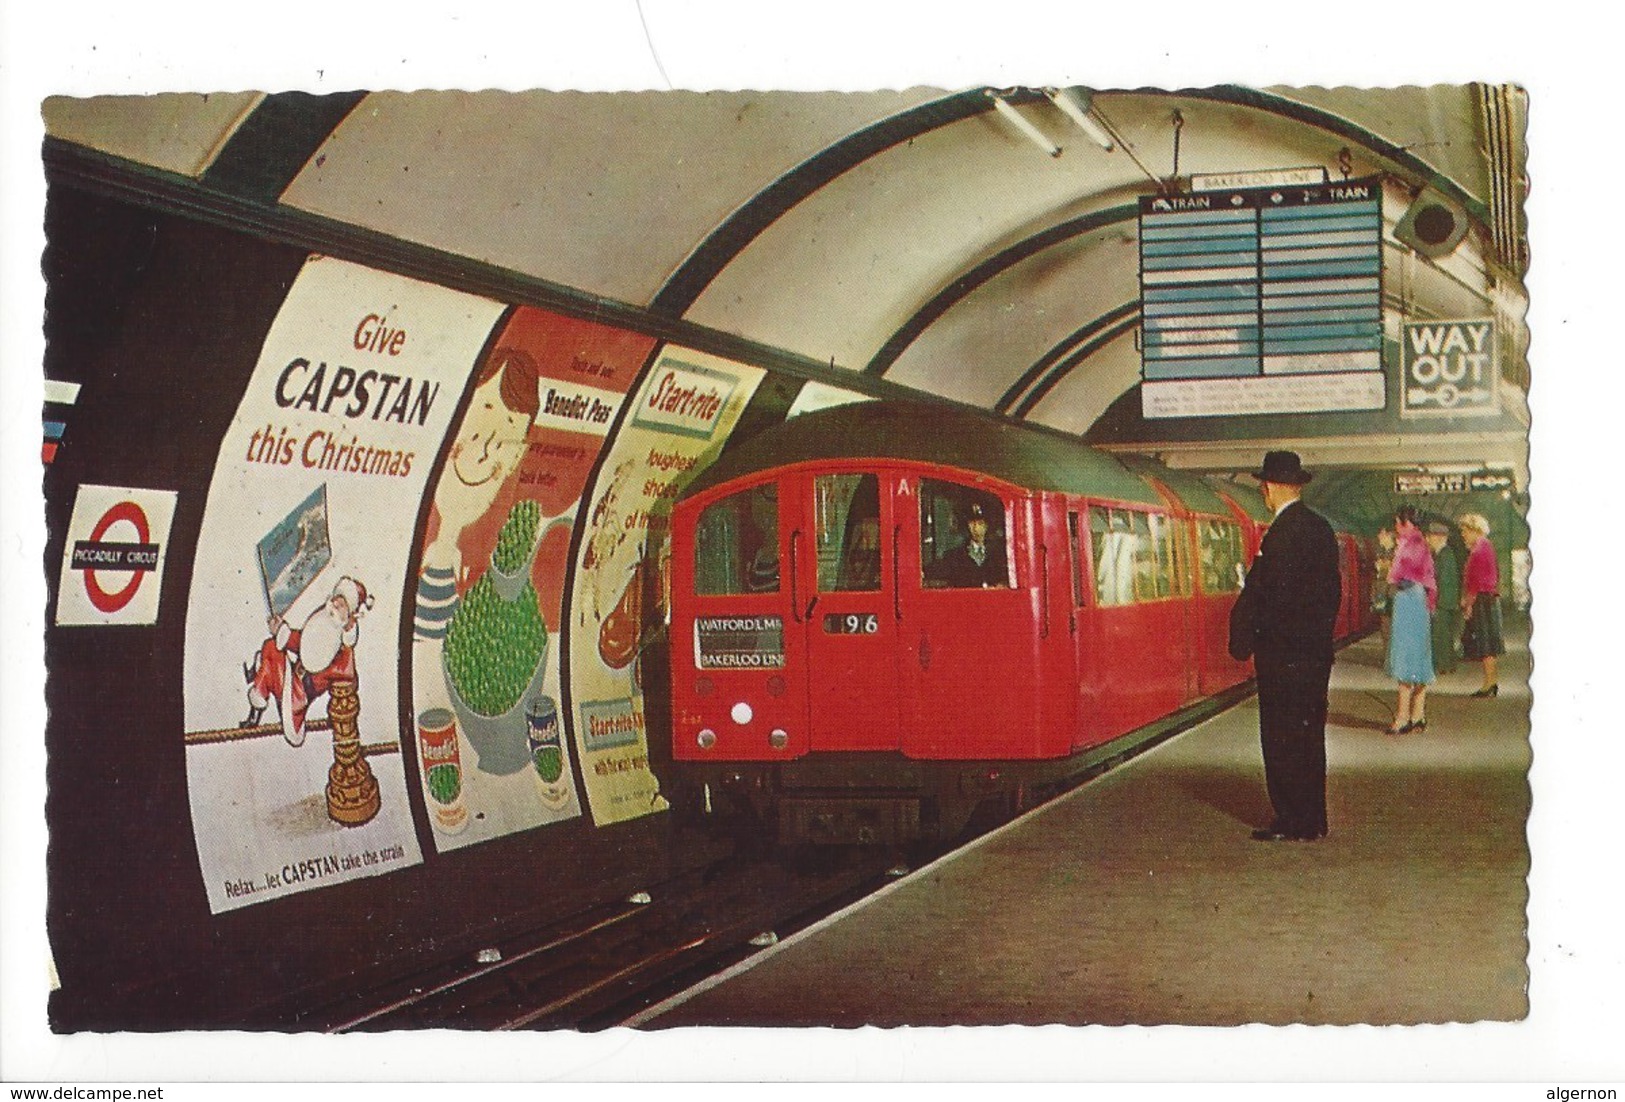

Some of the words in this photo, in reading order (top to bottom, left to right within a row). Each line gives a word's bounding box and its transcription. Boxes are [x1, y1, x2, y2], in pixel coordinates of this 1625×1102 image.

[1172, 196, 1210, 210] TRAIN
[1330, 187, 1369, 200] TRAIN
[353, 313, 406, 356] Give
[1410, 324, 1489, 354] WAY
[1412, 353, 1489, 384] OUT
[274, 357, 440, 426] CAPSTAN
[648, 371, 722, 421] Start-rite
[543, 387, 590, 421] Benedict
[586, 397, 612, 424] Peas
[246, 423, 298, 466] this
[301, 429, 415, 478] Christmas
[647, 448, 698, 472] toughest
[643, 477, 680, 498] shoes
[897, 478, 911, 496] A
[624, 512, 639, 530] of
[74, 549, 122, 563] PICCADILLY
[126, 551, 158, 564] CIRCUS
[846, 614, 878, 633] 96
[702, 654, 760, 666] BAKERLOO
[281, 854, 340, 885] CAPSTAN
[341, 855, 362, 871] take
[363, 849, 379, 865] the
[380, 843, 405, 863] strain
